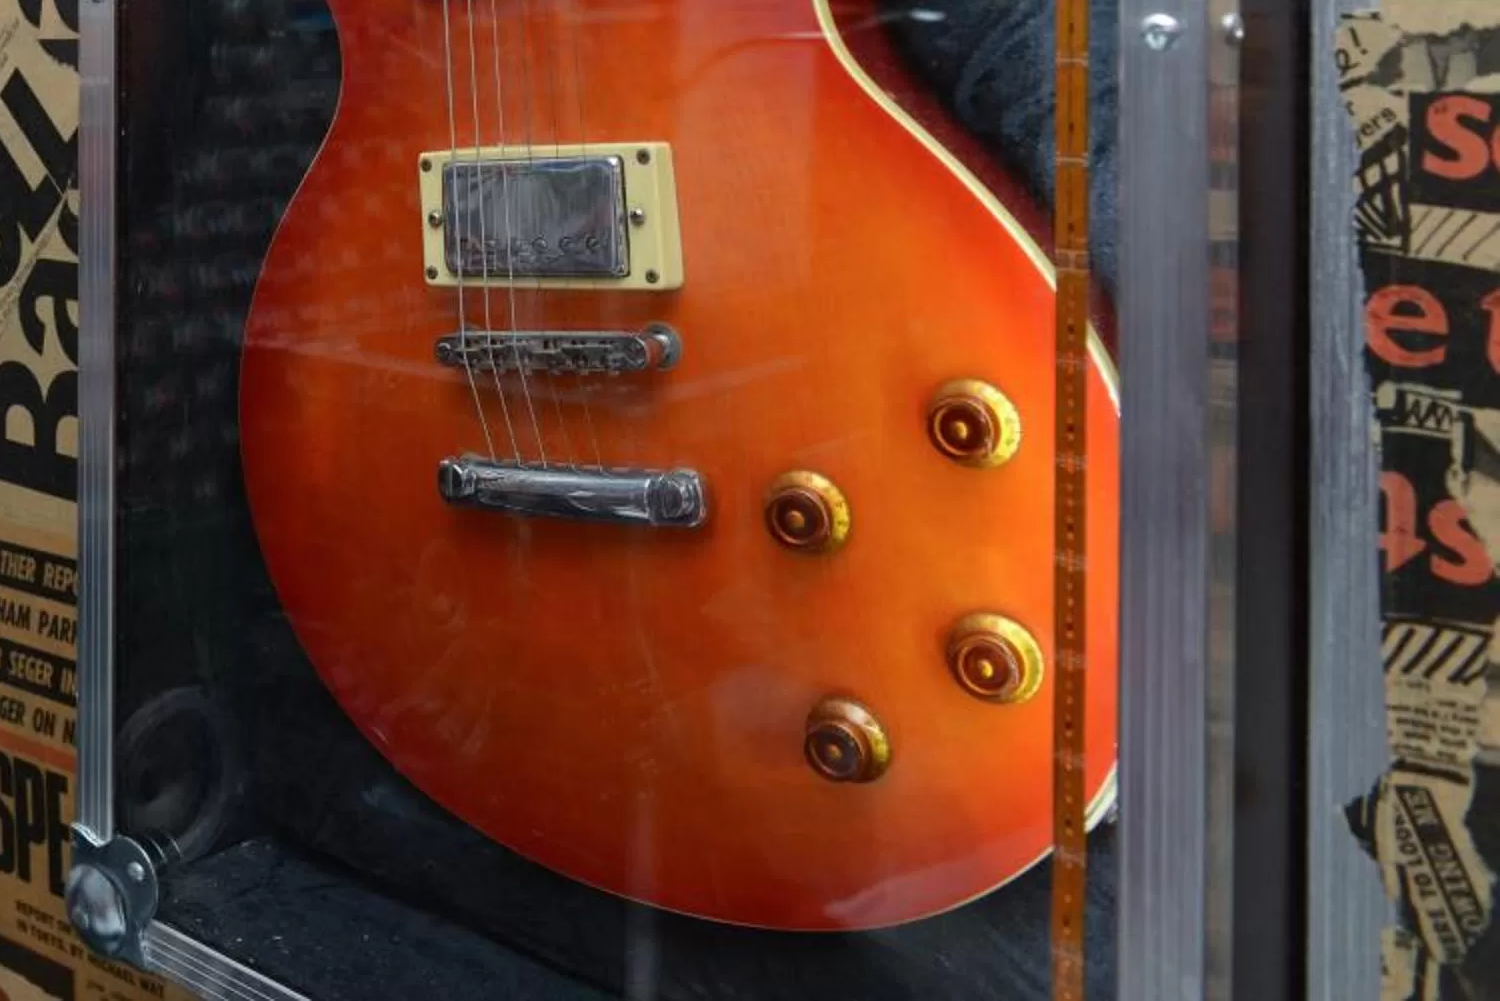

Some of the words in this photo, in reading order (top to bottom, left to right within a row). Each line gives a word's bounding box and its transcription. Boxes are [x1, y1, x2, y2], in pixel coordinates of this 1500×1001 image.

[1421, 94, 1500, 181] S
[9, 650, 54, 688] SEGER
[32, 706, 56, 739] ON
